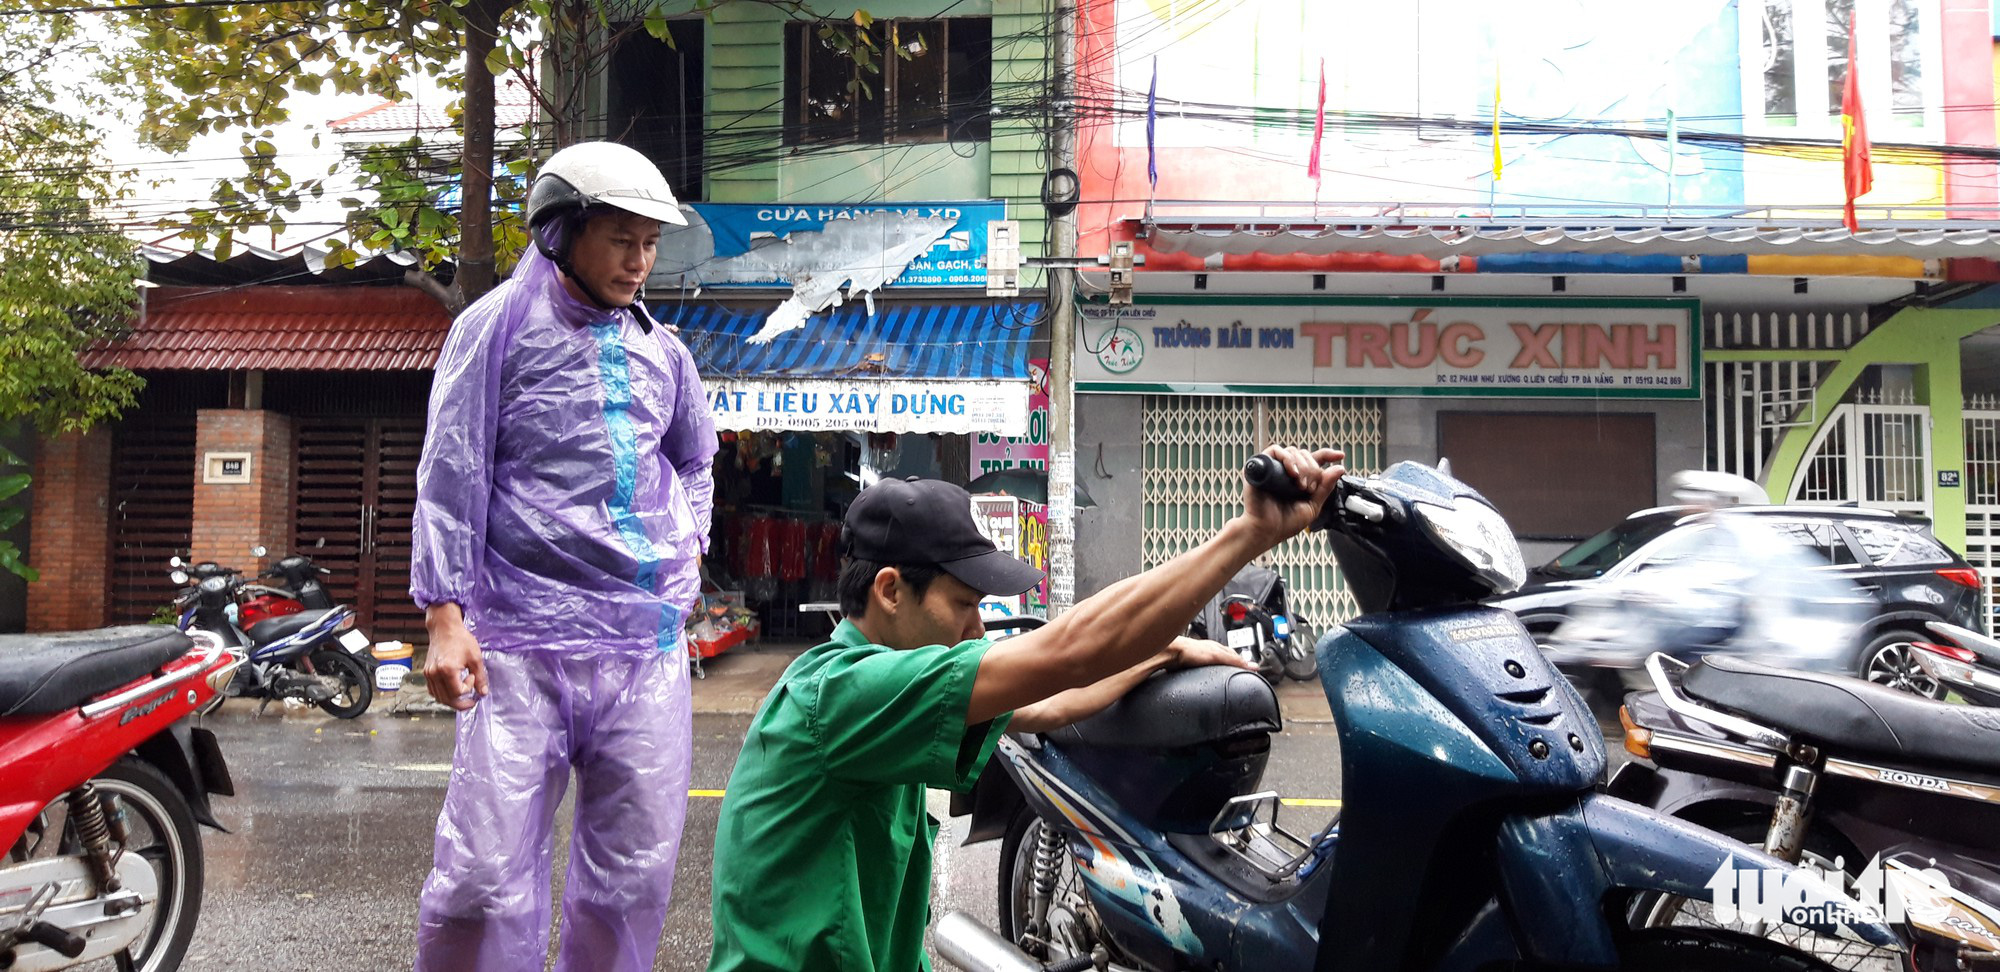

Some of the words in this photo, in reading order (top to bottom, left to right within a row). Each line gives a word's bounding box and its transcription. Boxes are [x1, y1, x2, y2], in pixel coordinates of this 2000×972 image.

[757, 206, 812, 221] CỬA
[937, 260, 972, 272] GẠCH,
[1258, 328, 1294, 349] NON
[1300, 308, 1486, 369] TRÚC
[1507, 323, 1677, 370] XINH
[1450, 374, 1458, 383] 82
[1656, 376, 1668, 385] 842
[1670, 376, 1682, 385] 869
[757, 386, 817, 418] LIỆU
[828, 387, 881, 414] XÂY
[891, 390, 965, 419] DỰNG
[788, 417, 820, 428] 0905
[825, 418, 849, 428] 205
[853, 418, 878, 428] 004
[1449, 624, 1519, 641] HONDA
[1878, 770, 1951, 791] HONDA
